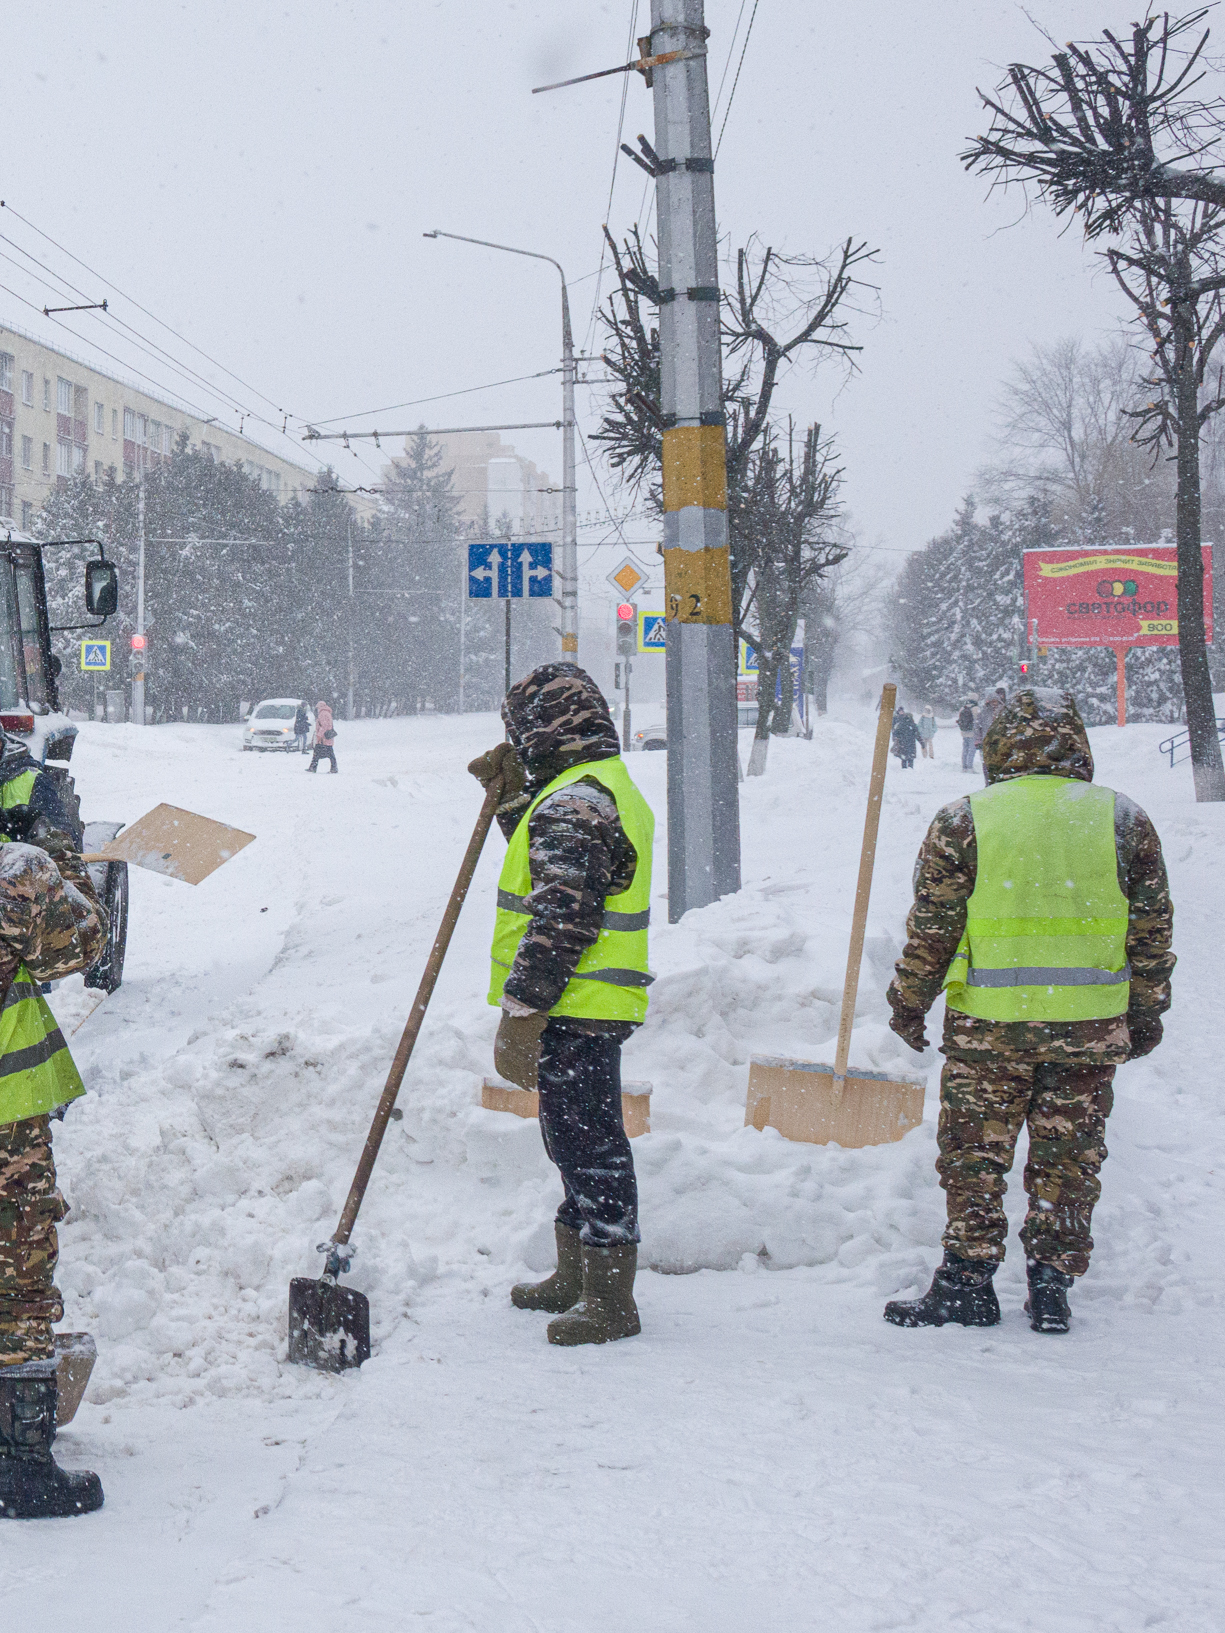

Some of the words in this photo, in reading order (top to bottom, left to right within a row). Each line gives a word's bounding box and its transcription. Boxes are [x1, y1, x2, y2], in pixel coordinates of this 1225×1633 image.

[1051, 560, 1098, 574] СЭКОНОМИЛ
[1104, 558, 1135, 566] ЗНАЧИТ
[1137, 560, 1178, 570] ЗАРАБОТА
